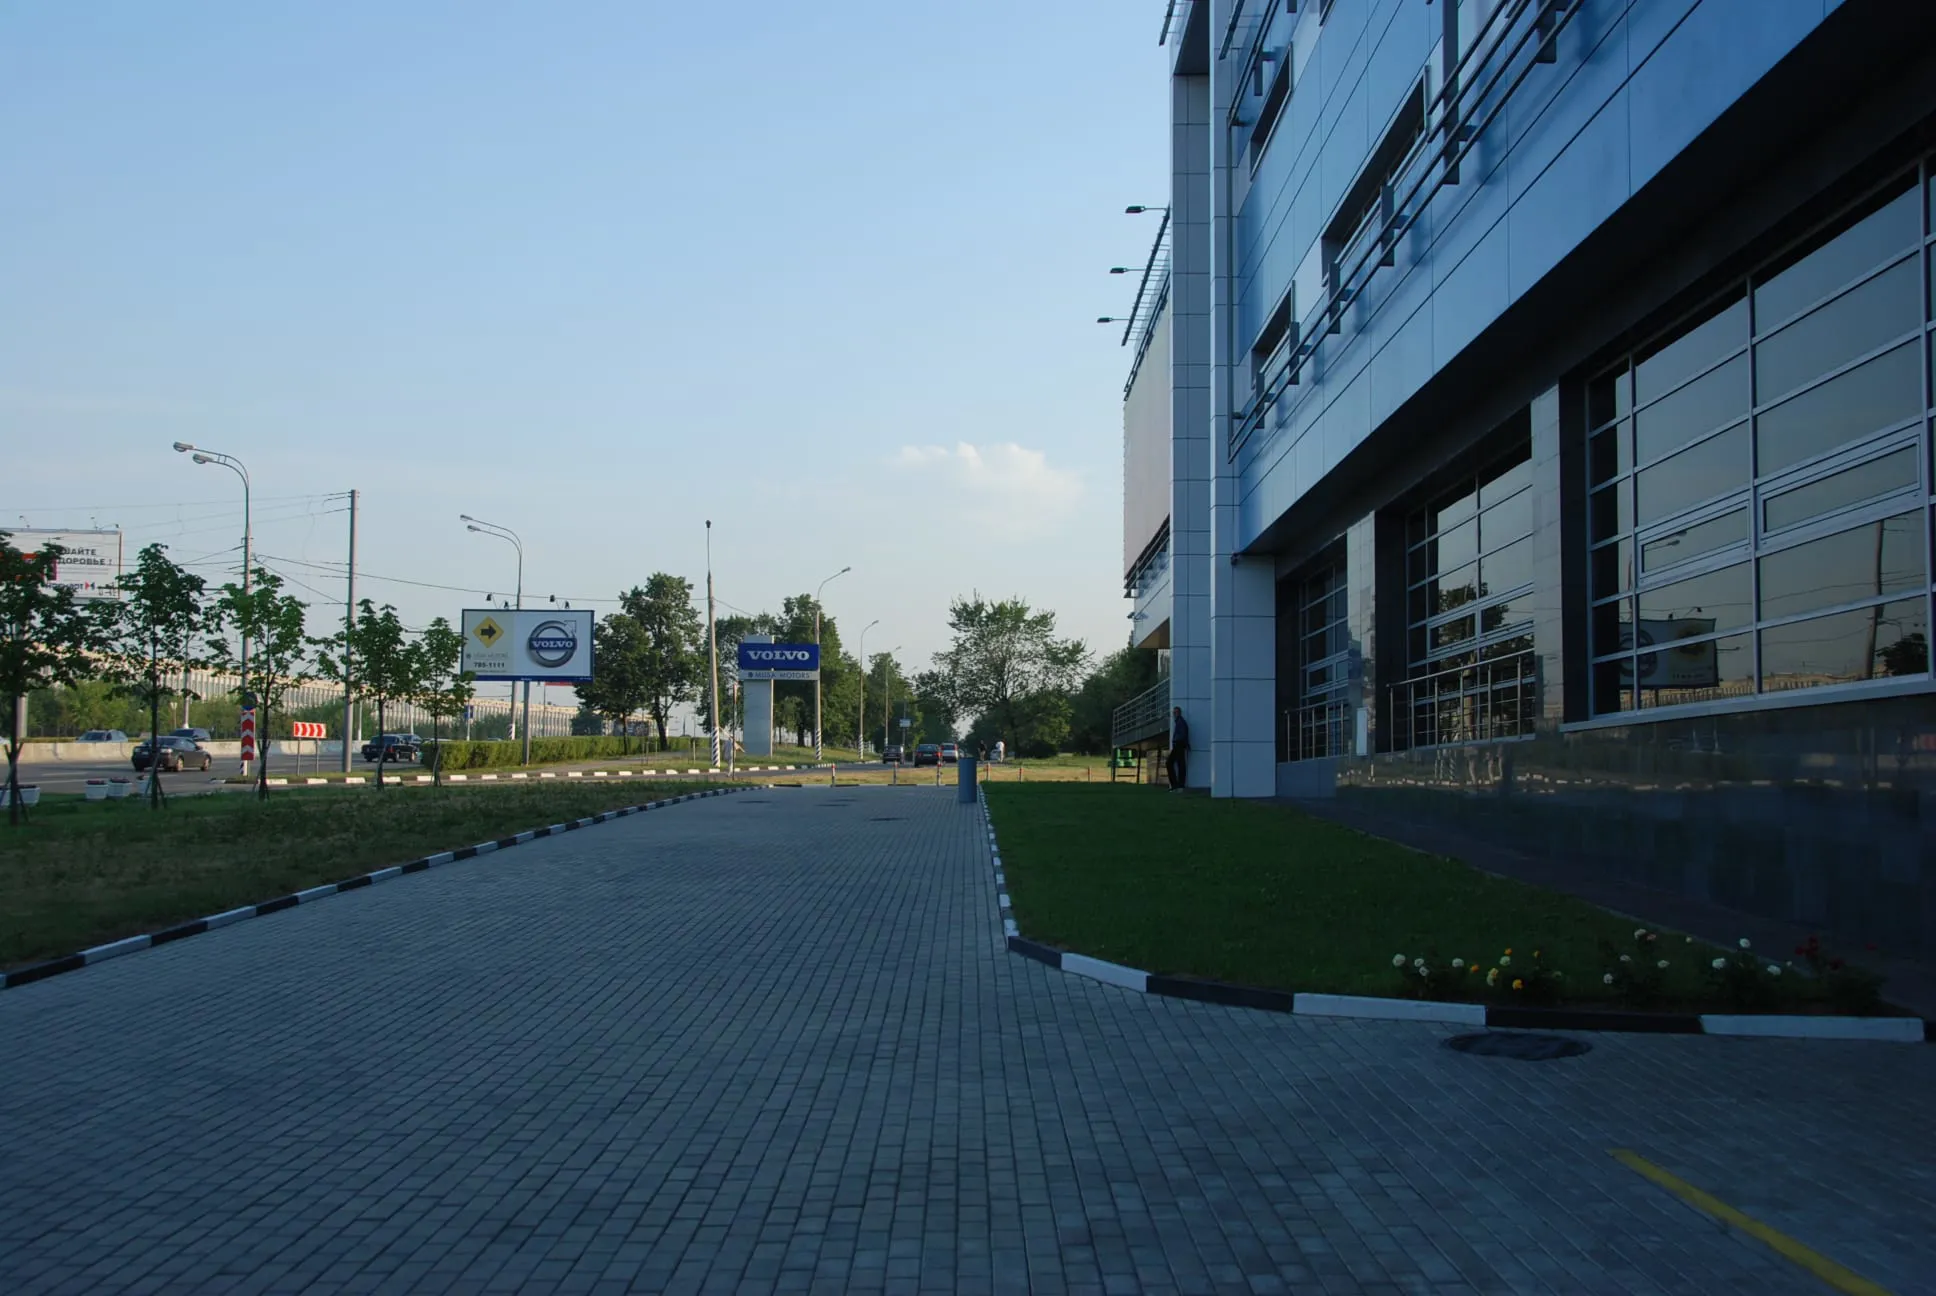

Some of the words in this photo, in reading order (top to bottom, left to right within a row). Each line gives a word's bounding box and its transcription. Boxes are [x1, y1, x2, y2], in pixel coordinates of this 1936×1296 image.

[61, 547, 96, 556] ШАЙТЕ
[57, 557, 105, 566] ДОРОВЬЕ
[532, 640, 573, 648] VOLVO
[746, 650, 810, 661] VOLVO
[779, 671, 810, 679] MOTORS
